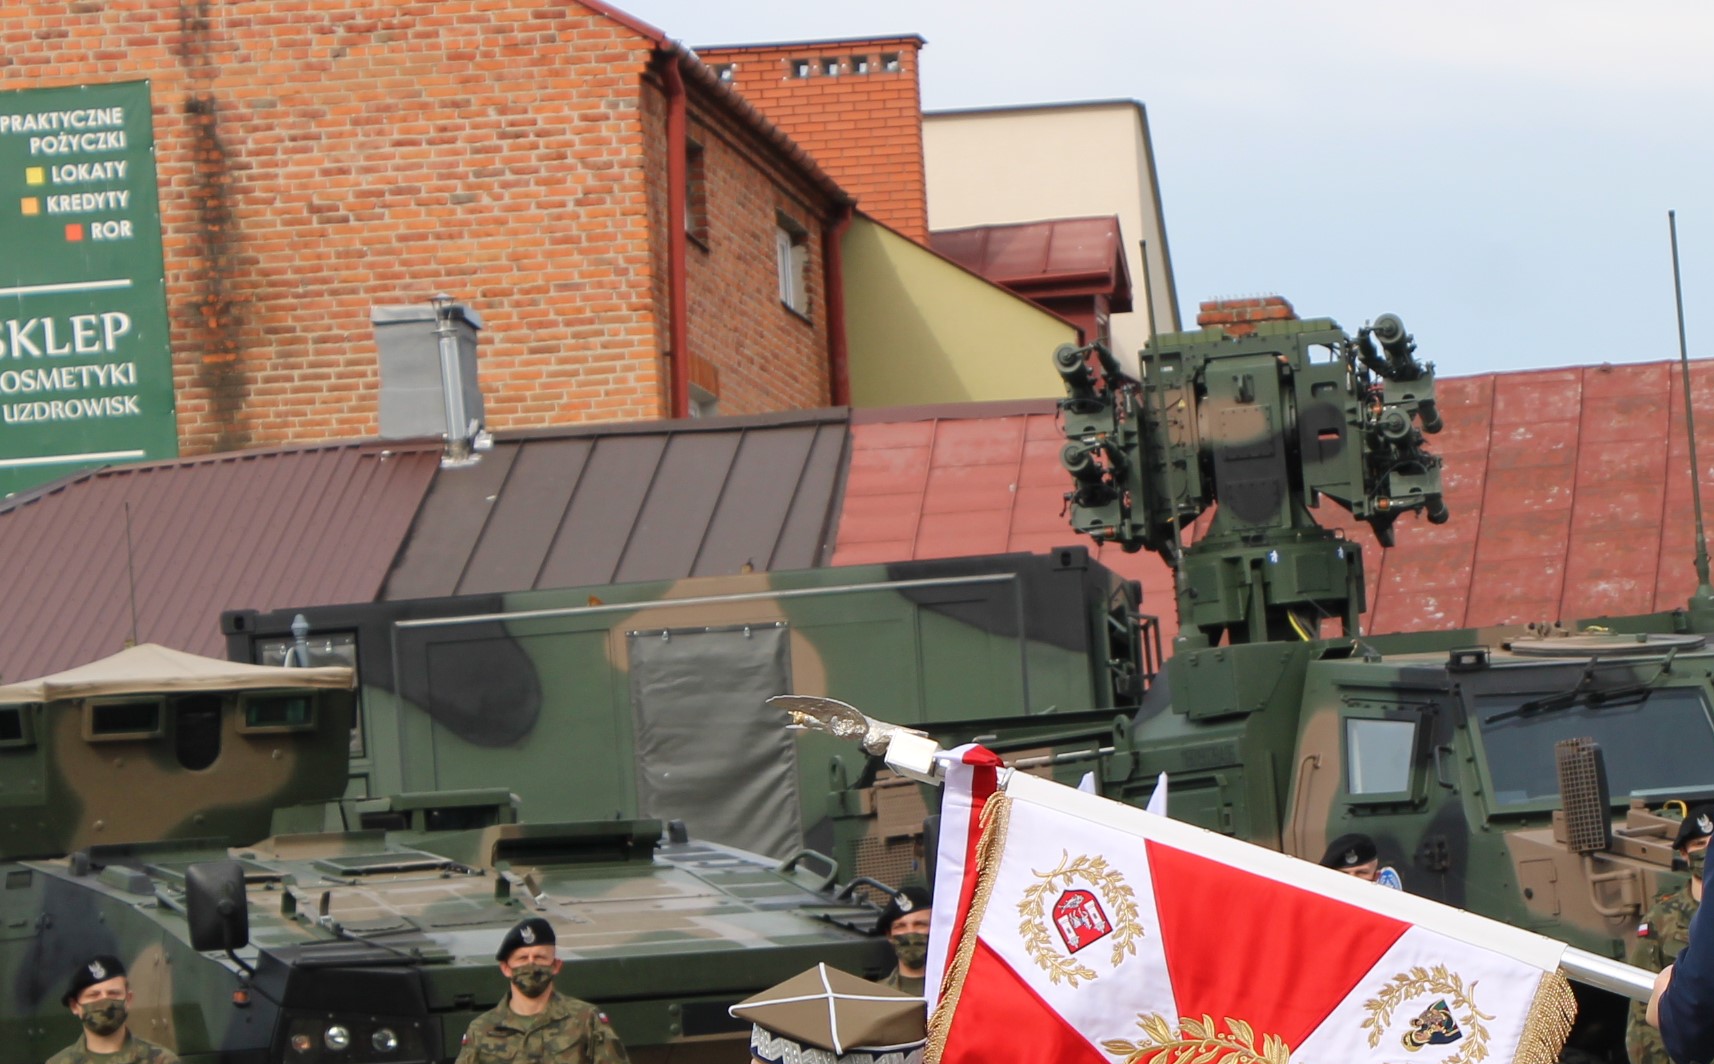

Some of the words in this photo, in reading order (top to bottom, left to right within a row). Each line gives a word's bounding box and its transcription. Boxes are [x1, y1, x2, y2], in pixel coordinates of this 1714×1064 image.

[0, 107, 124, 132] PRAKTYCZNE
[30, 131, 127, 155] POŻYCZKI
[52, 160, 127, 182] LOKATY
[47, 190, 129, 213] KREDYTY
[91, 220, 132, 240] ROR
[0, 362, 136, 393] OSMETYKI
[3, 395, 140, 424] UZDROWISK
